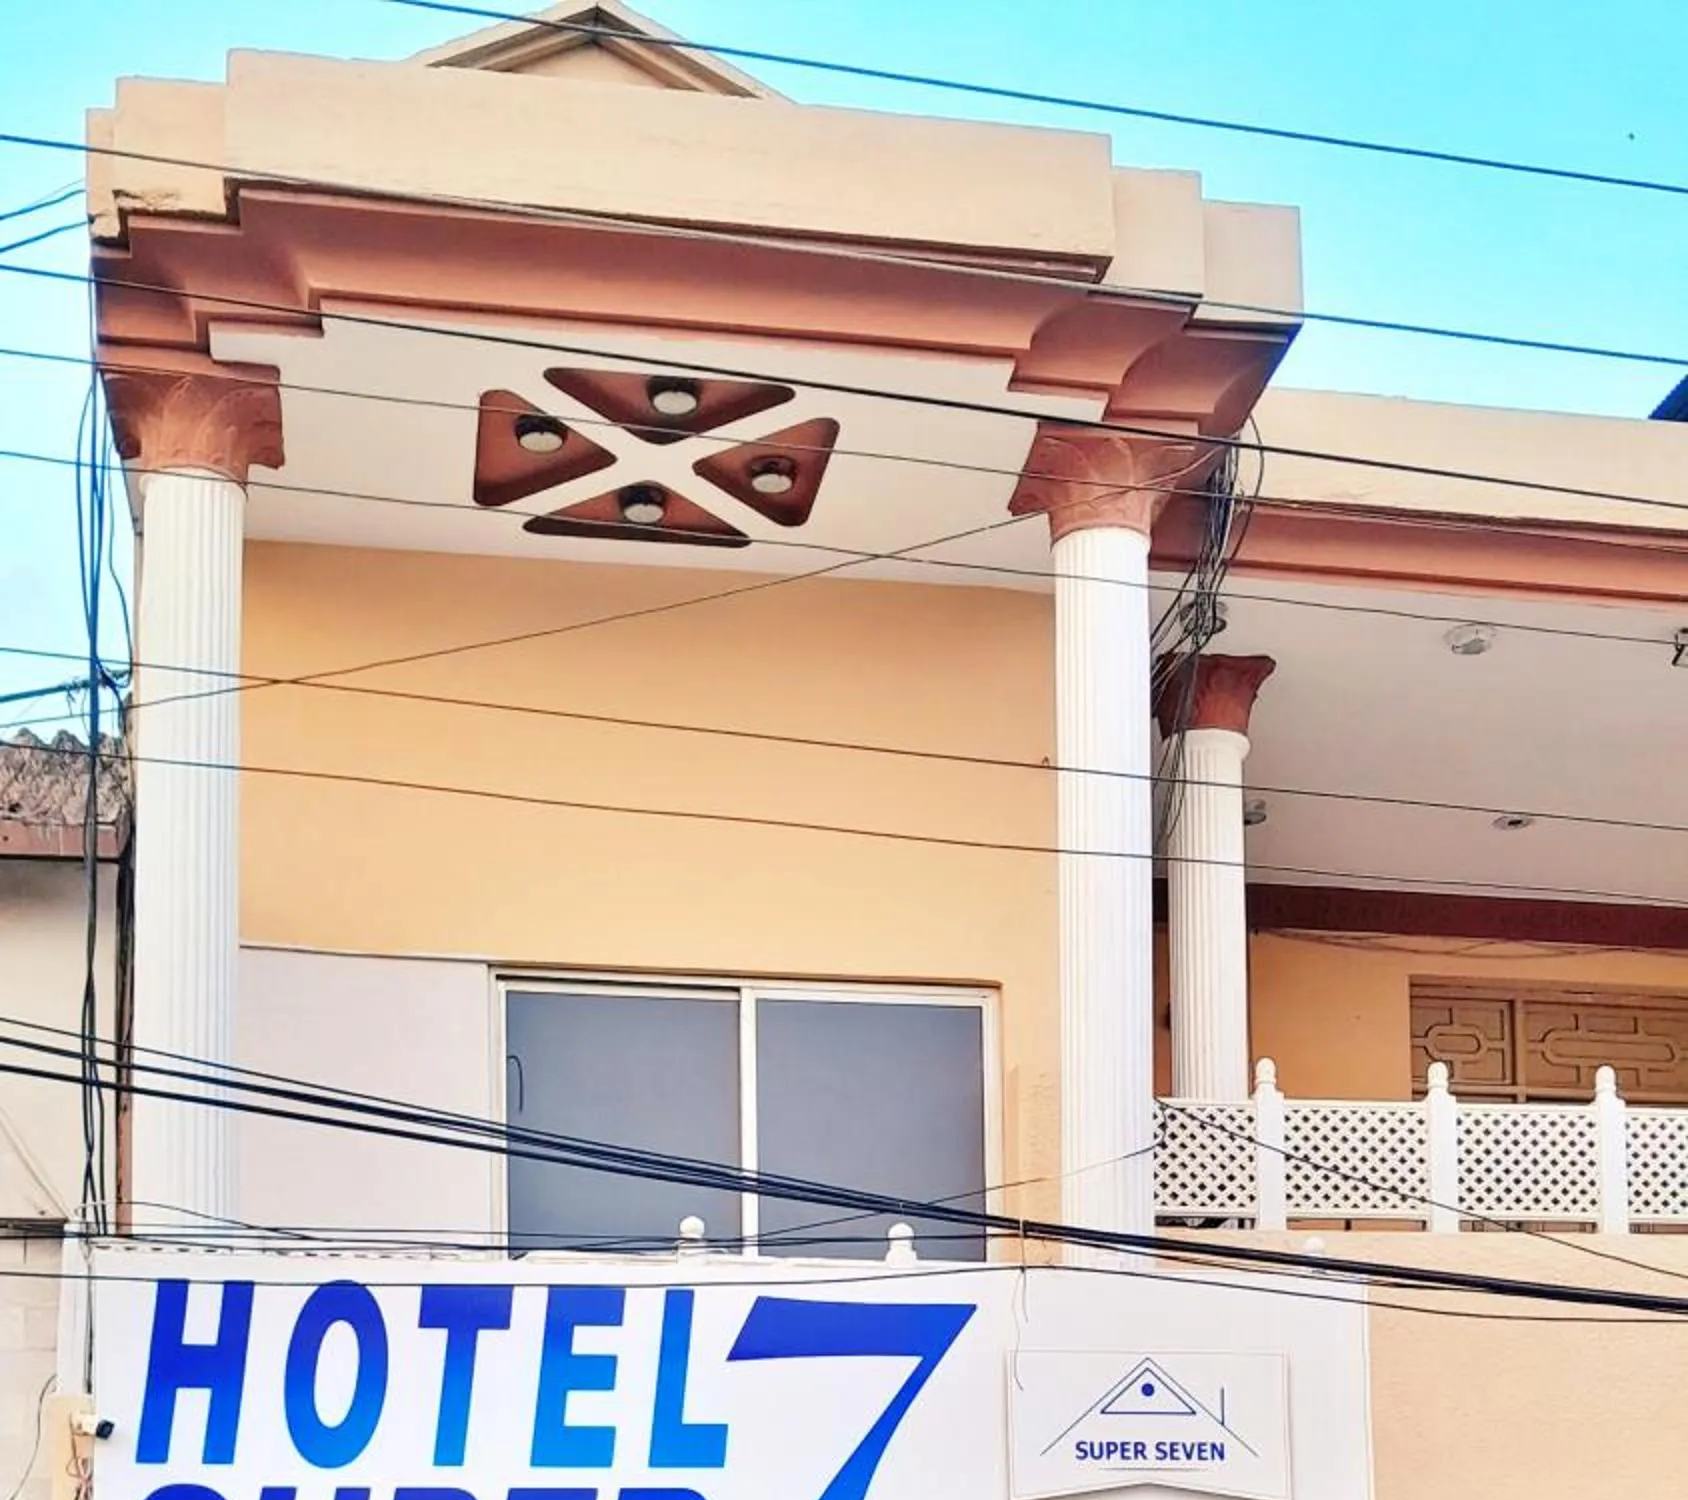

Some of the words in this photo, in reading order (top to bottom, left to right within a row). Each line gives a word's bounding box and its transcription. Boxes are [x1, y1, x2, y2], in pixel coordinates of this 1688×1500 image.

[135, 1279, 728, 1469] HOTEL
[1075, 1440, 1148, 1461] SUPER
[1155, 1440, 1225, 1461] SEVEN
